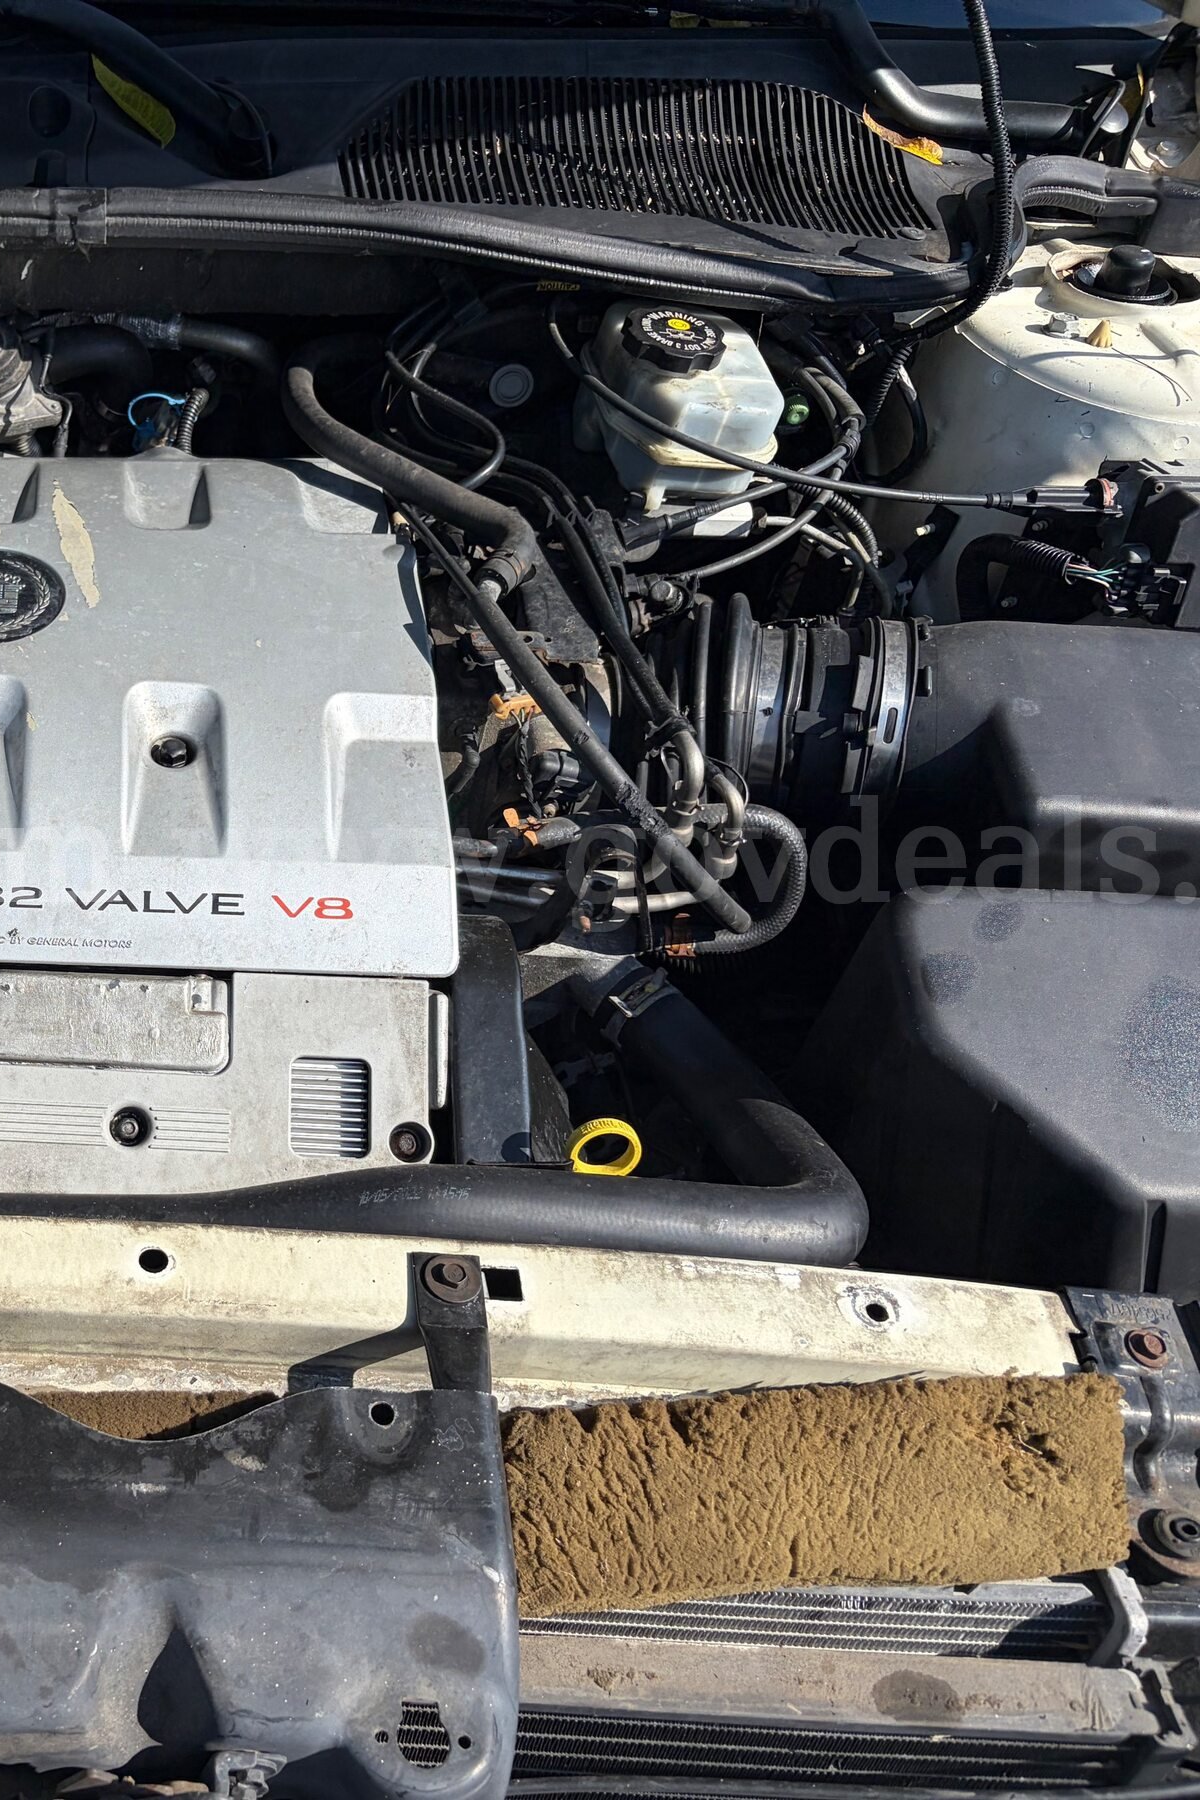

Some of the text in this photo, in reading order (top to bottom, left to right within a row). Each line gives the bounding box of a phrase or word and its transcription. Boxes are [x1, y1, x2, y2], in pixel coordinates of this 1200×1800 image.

[647, 311, 705, 327] WARNING
[647, 331, 674, 347] BRAKE
[64, 887, 246, 916] VALVE
[271, 895, 354, 920] V8
[9, 936, 24, 945] BY
[26, 936, 79, 947] GENERAL
[81, 939, 133, 949] MOTORS
